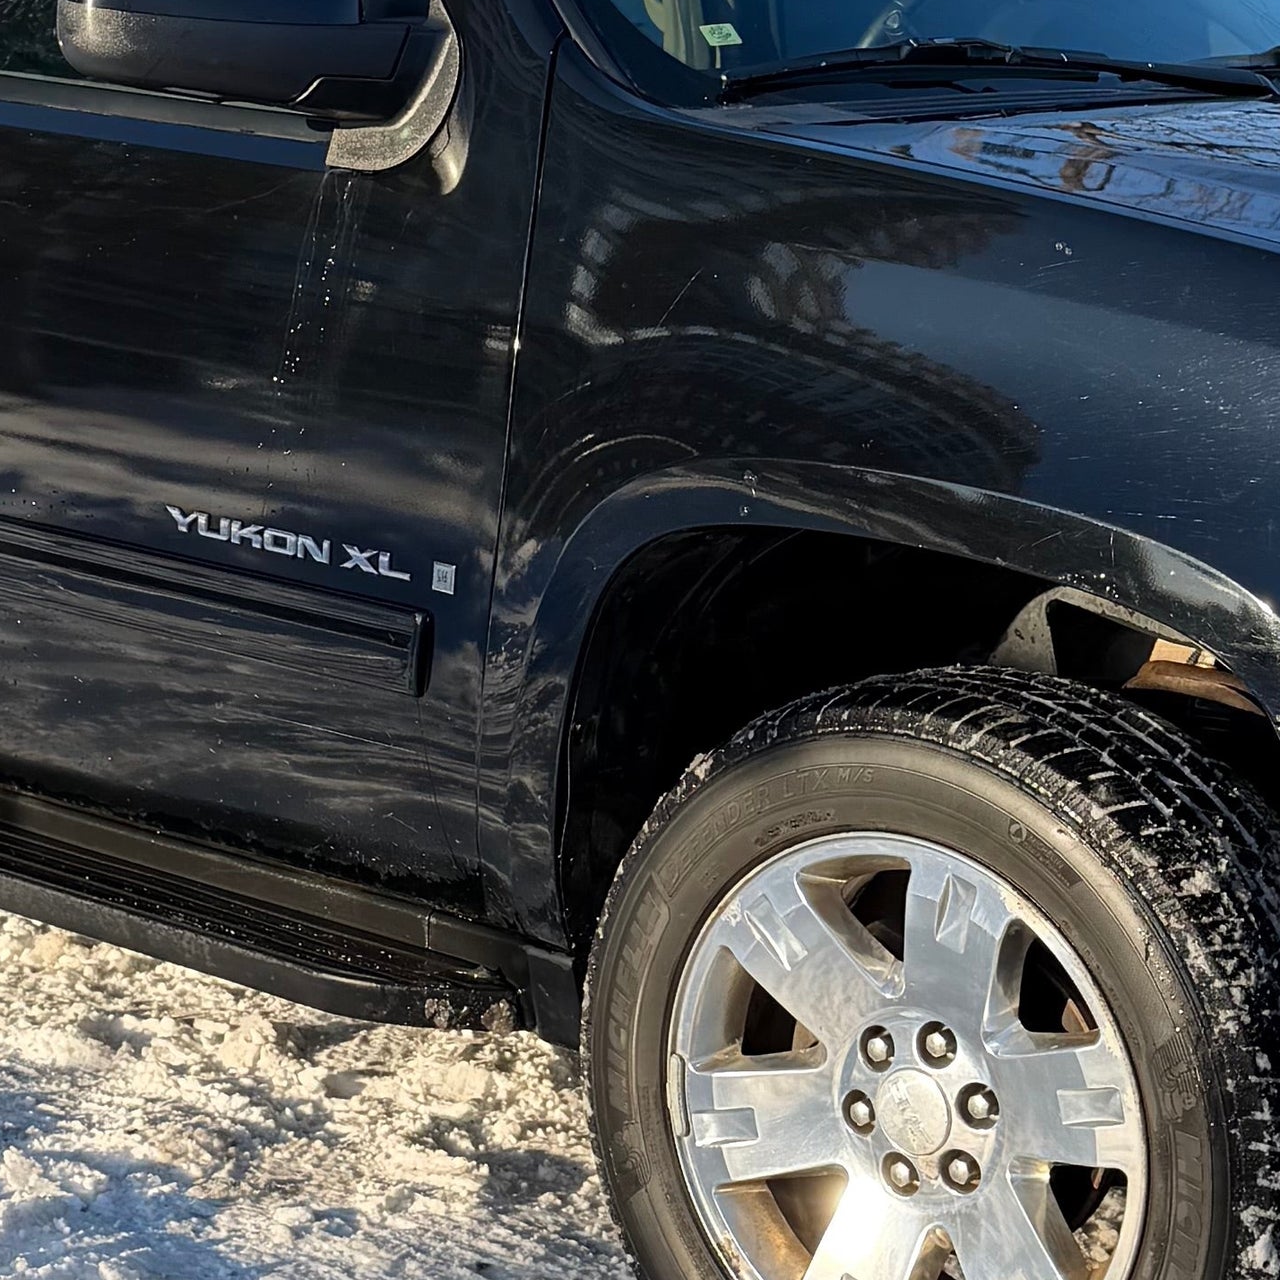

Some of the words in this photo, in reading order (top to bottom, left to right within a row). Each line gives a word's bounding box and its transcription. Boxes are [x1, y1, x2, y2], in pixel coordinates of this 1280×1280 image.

[166, 504, 331, 565] YUKON
[340, 543, 411, 582] XL
[664, 788, 770, 884] DEFENDER
[782, 770, 831, 798] LTX
[837, 768, 874, 785] M/S
[607, 890, 662, 1115] MICHELIN
